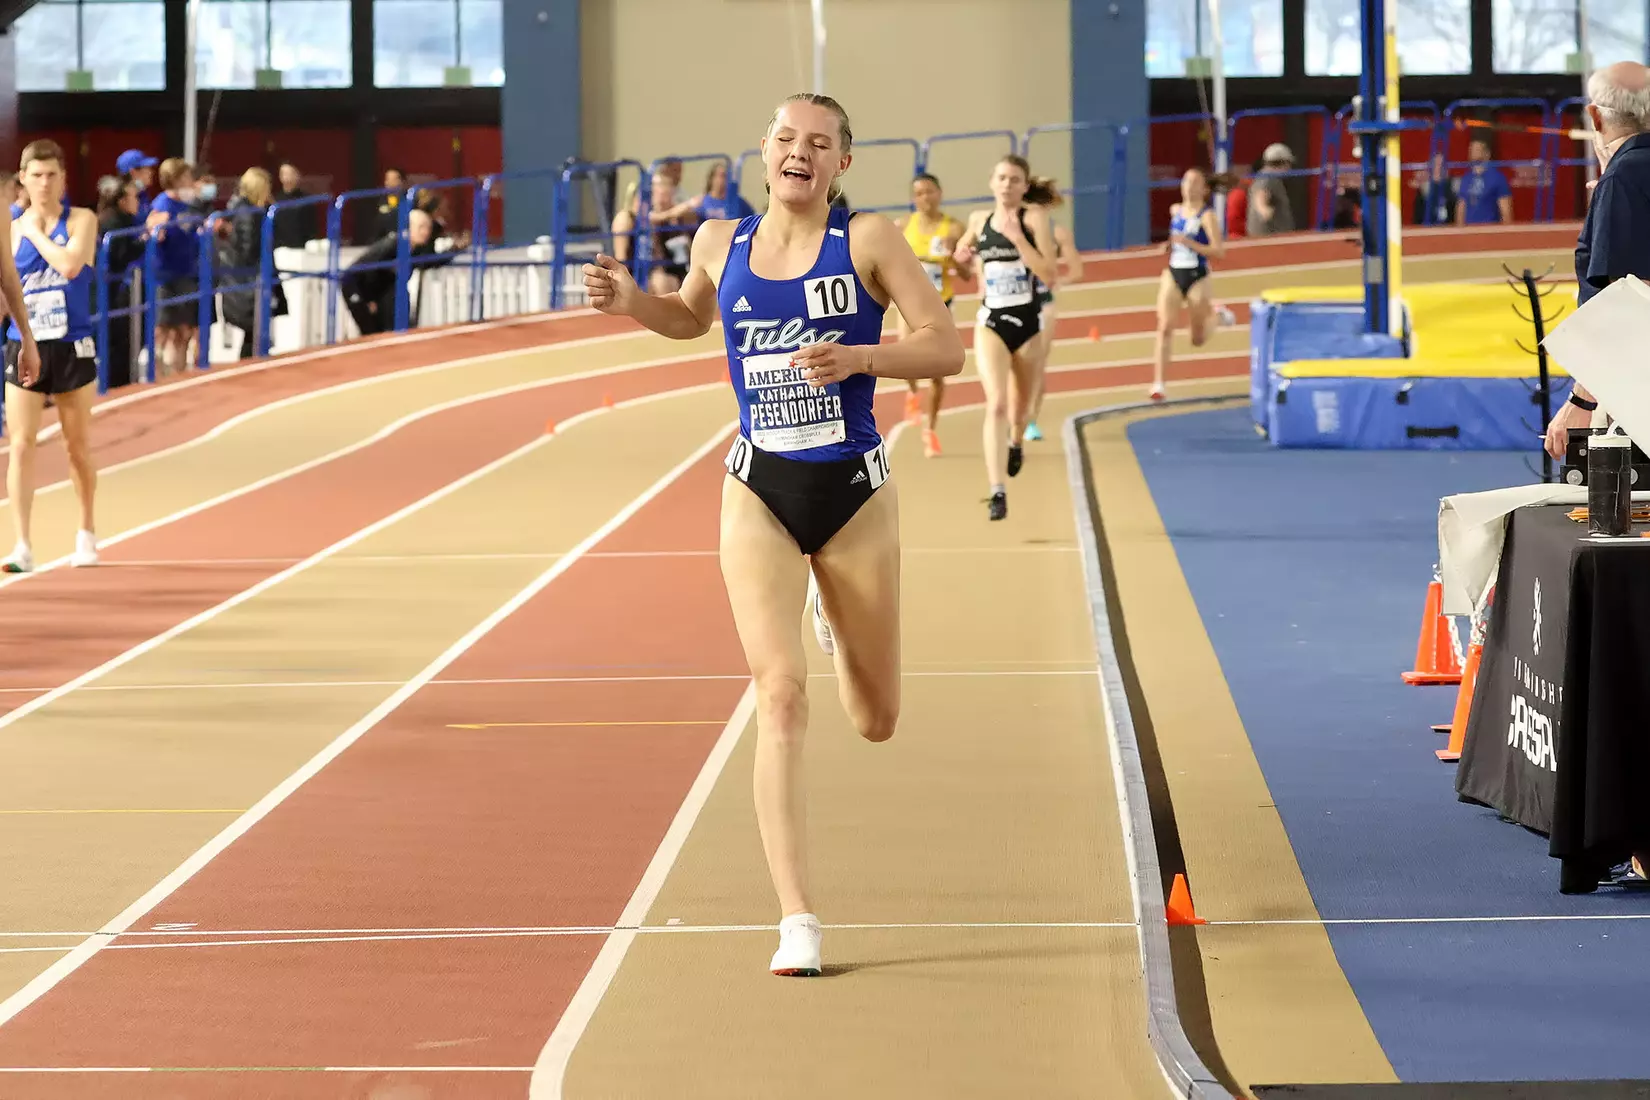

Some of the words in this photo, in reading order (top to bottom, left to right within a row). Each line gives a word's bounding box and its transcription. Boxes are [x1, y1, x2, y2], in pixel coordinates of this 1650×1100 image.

[814, 278, 848, 315] 10
[733, 316, 846, 354] Tulsa
[748, 366, 821, 387] AMERIC
[757, 384, 827, 402] KATHARINA
[750, 395, 842, 428] PESENDORFER
